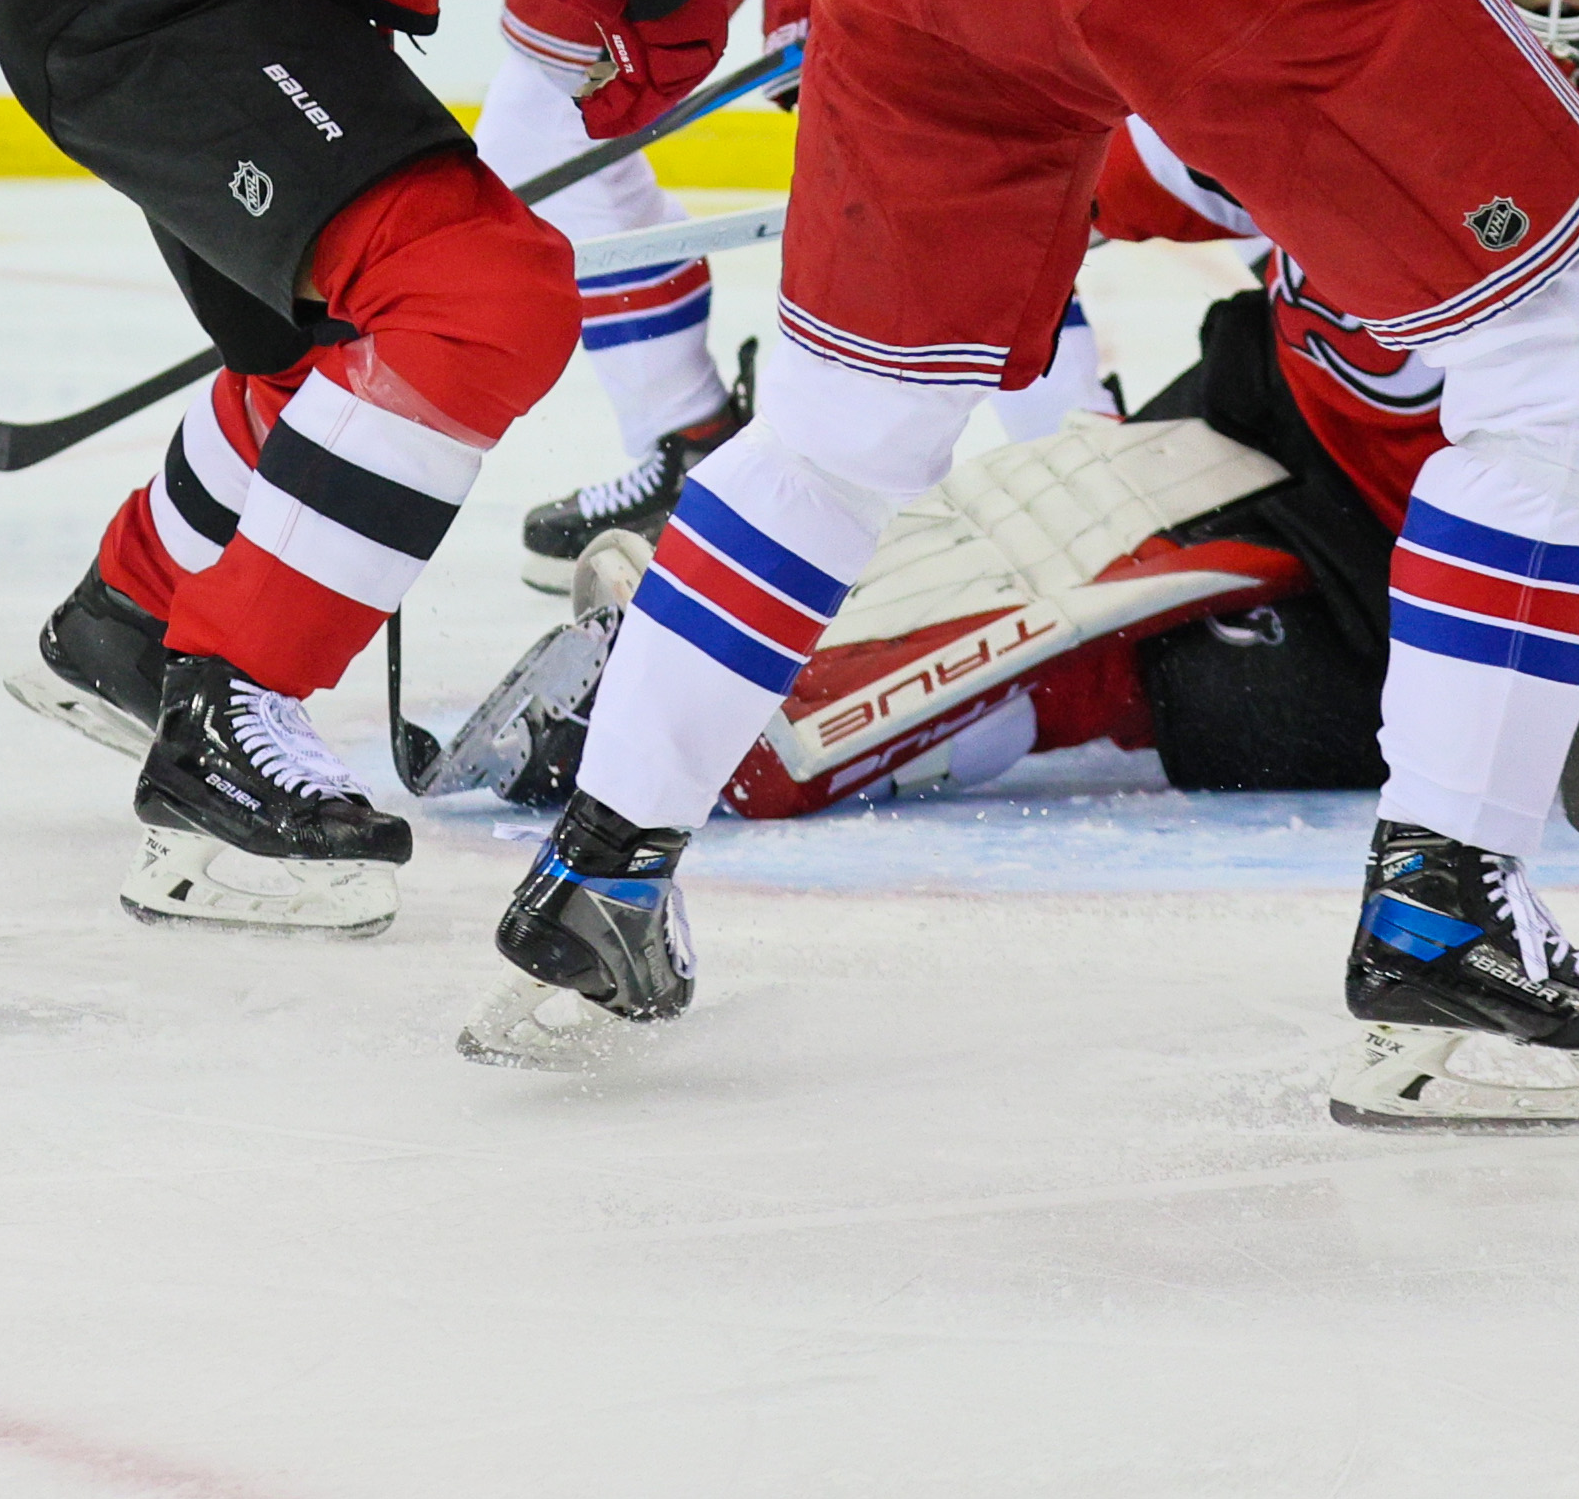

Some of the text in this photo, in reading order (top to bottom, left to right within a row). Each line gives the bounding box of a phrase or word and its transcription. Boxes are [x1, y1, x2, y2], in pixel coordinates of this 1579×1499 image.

[261, 63, 344, 142] BAUER
[818, 618, 1058, 747] TRUE
[204, 773, 262, 813] BAUER
[1474, 958, 1560, 1004] BAUER
